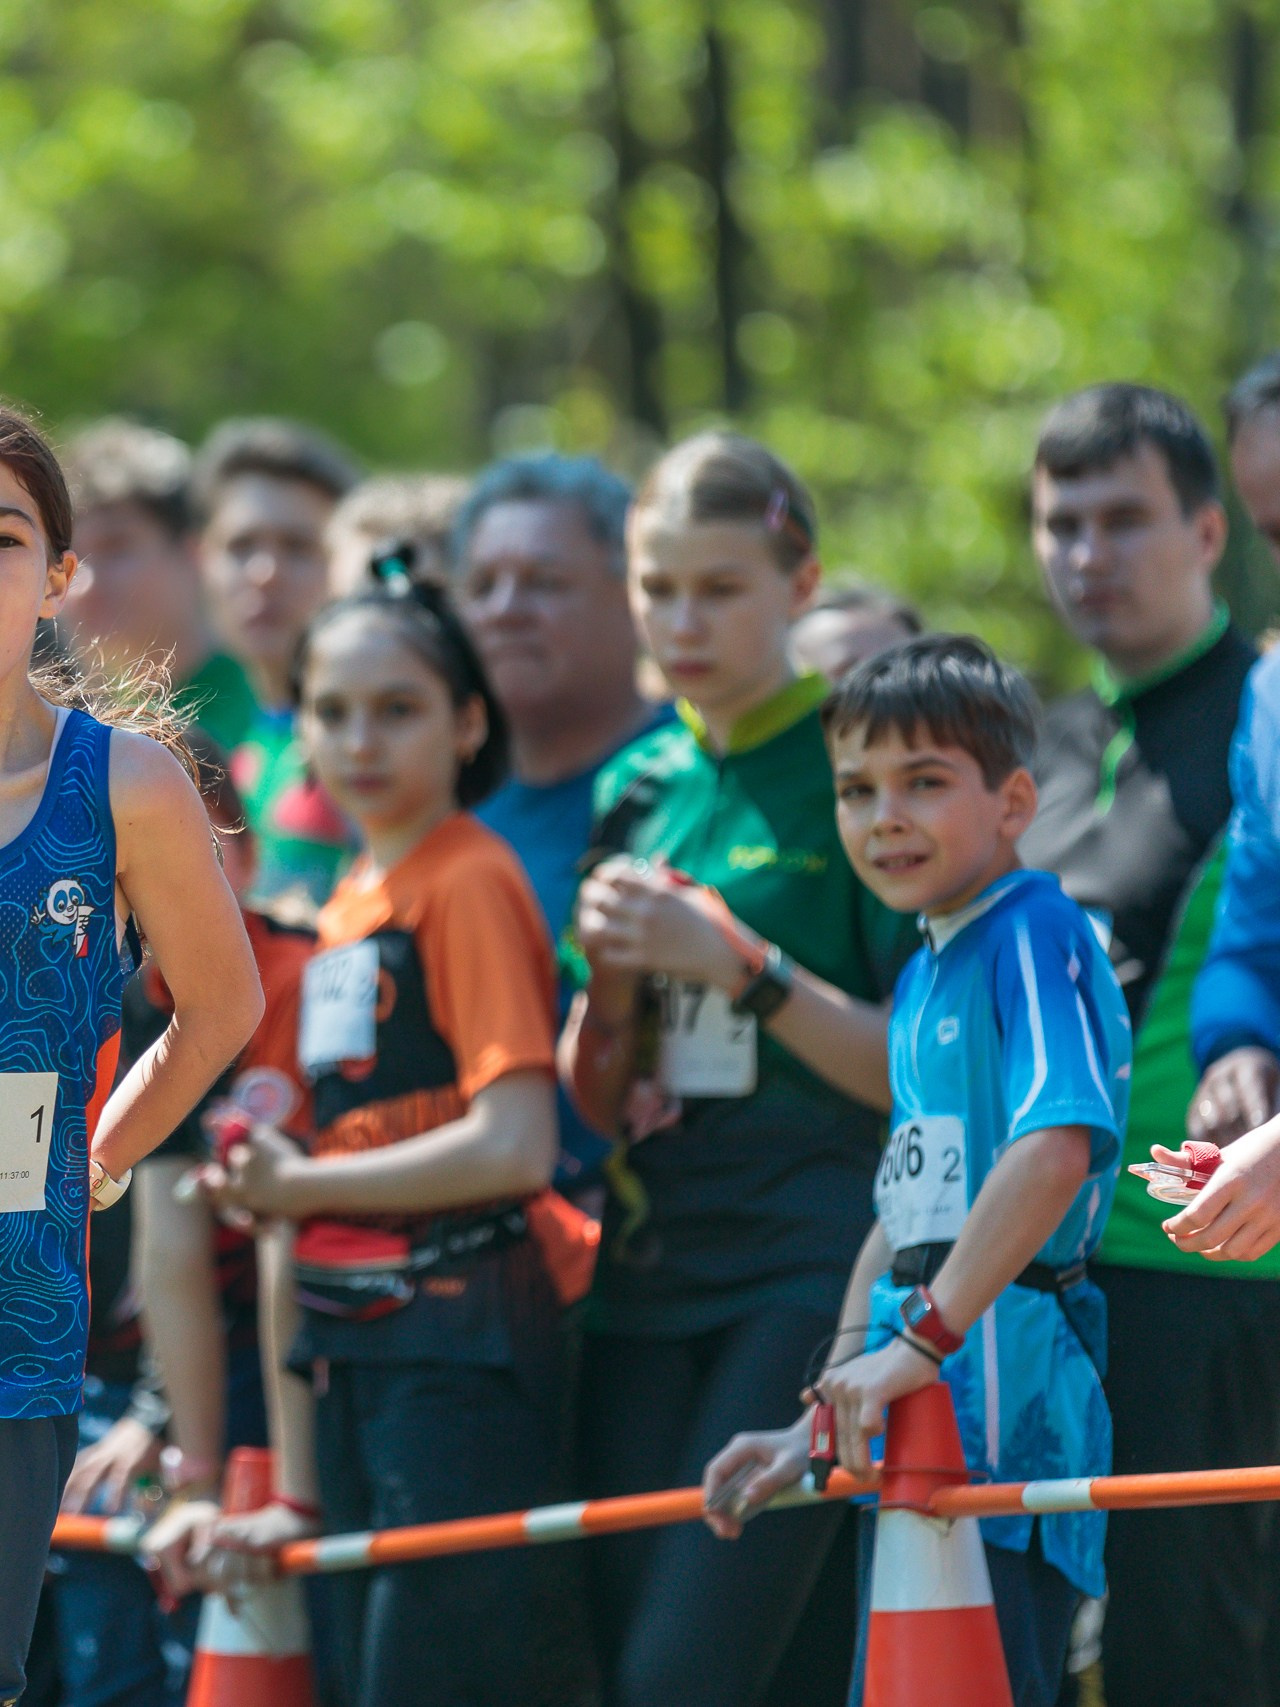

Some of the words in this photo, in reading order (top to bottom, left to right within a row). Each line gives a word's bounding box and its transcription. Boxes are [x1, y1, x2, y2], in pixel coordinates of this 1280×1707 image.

[30, 1105, 45, 1143] 1
[0, 1170, 30, 1180] 11:37:00
[942, 1146, 961, 1182] 2
